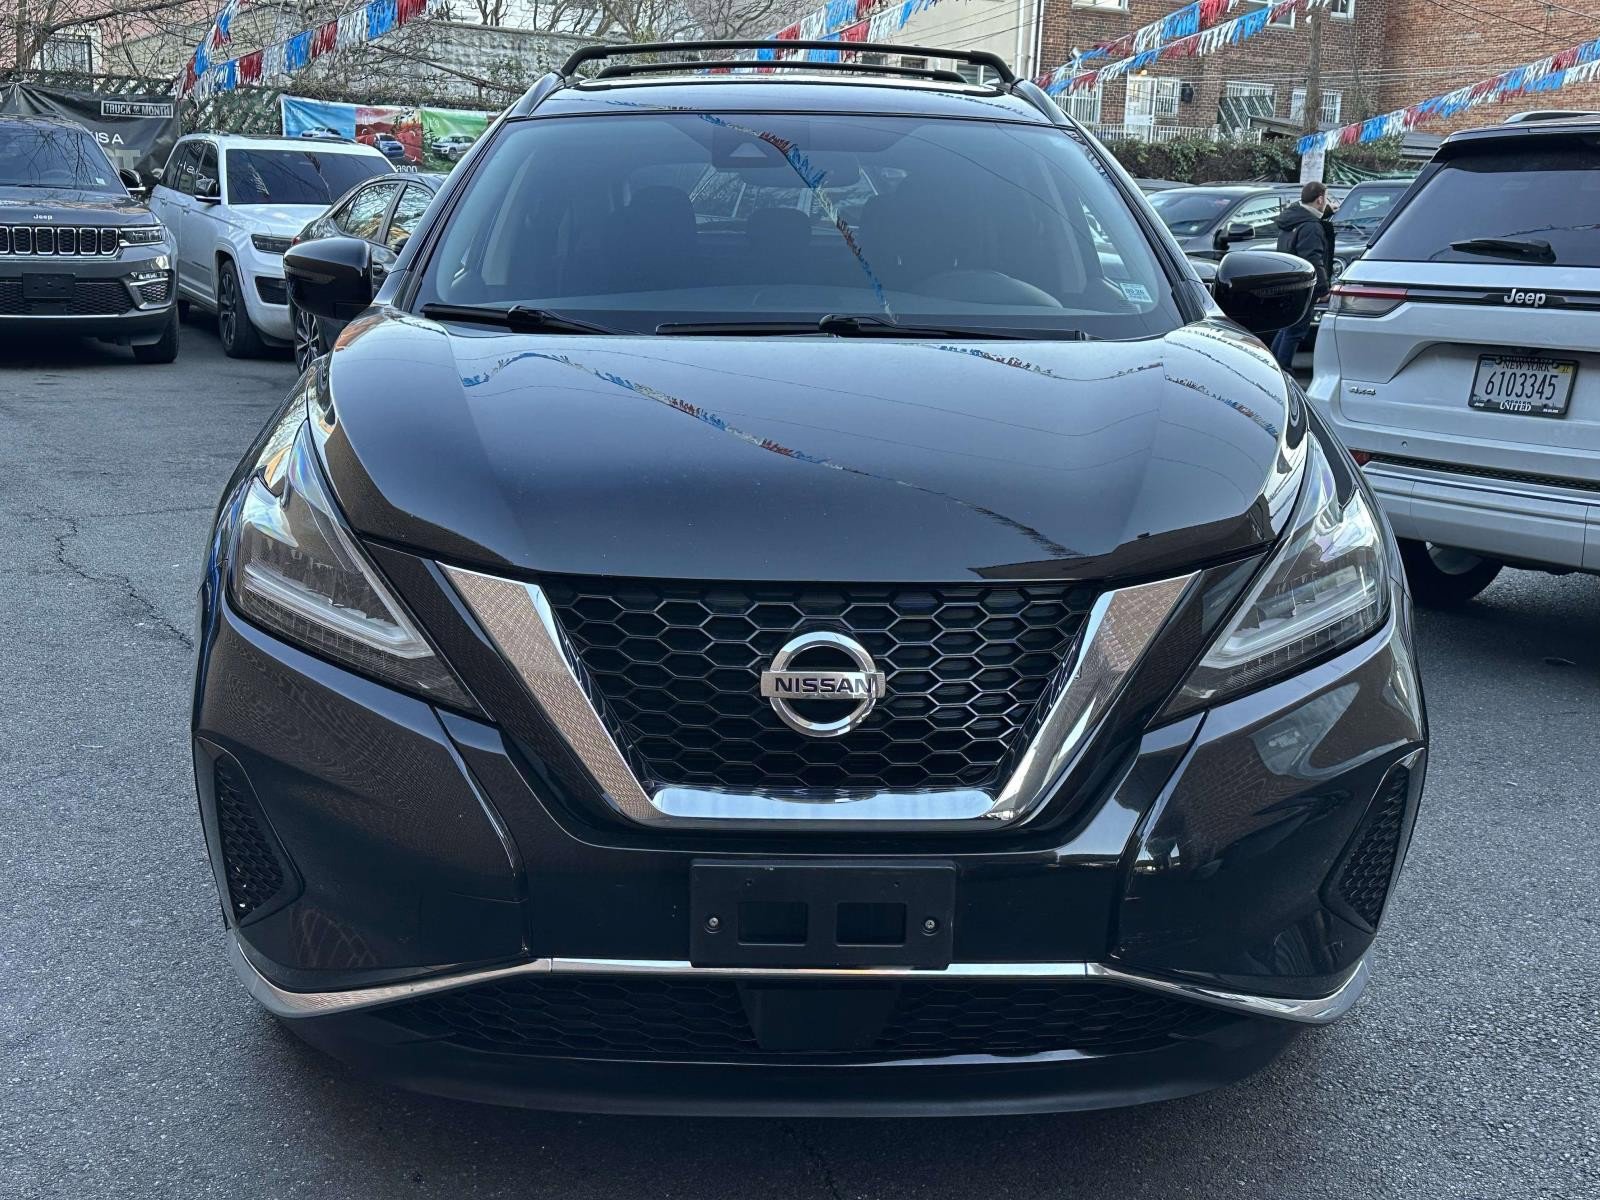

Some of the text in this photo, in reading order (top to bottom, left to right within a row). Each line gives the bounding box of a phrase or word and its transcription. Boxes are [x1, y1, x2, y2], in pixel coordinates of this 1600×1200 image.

[104, 103, 170, 116] TRUCK MONTH
[111, 133, 124, 145] A
[1503, 288, 1546, 308] Jeep
[1502, 360, 1524, 371] NEW
[1526, 361, 1551, 373] YORK
[1485, 371, 1558, 401] 6103345
[1500, 401, 1532, 412] UNITED
[775, 677, 874, 694] NISSAN
